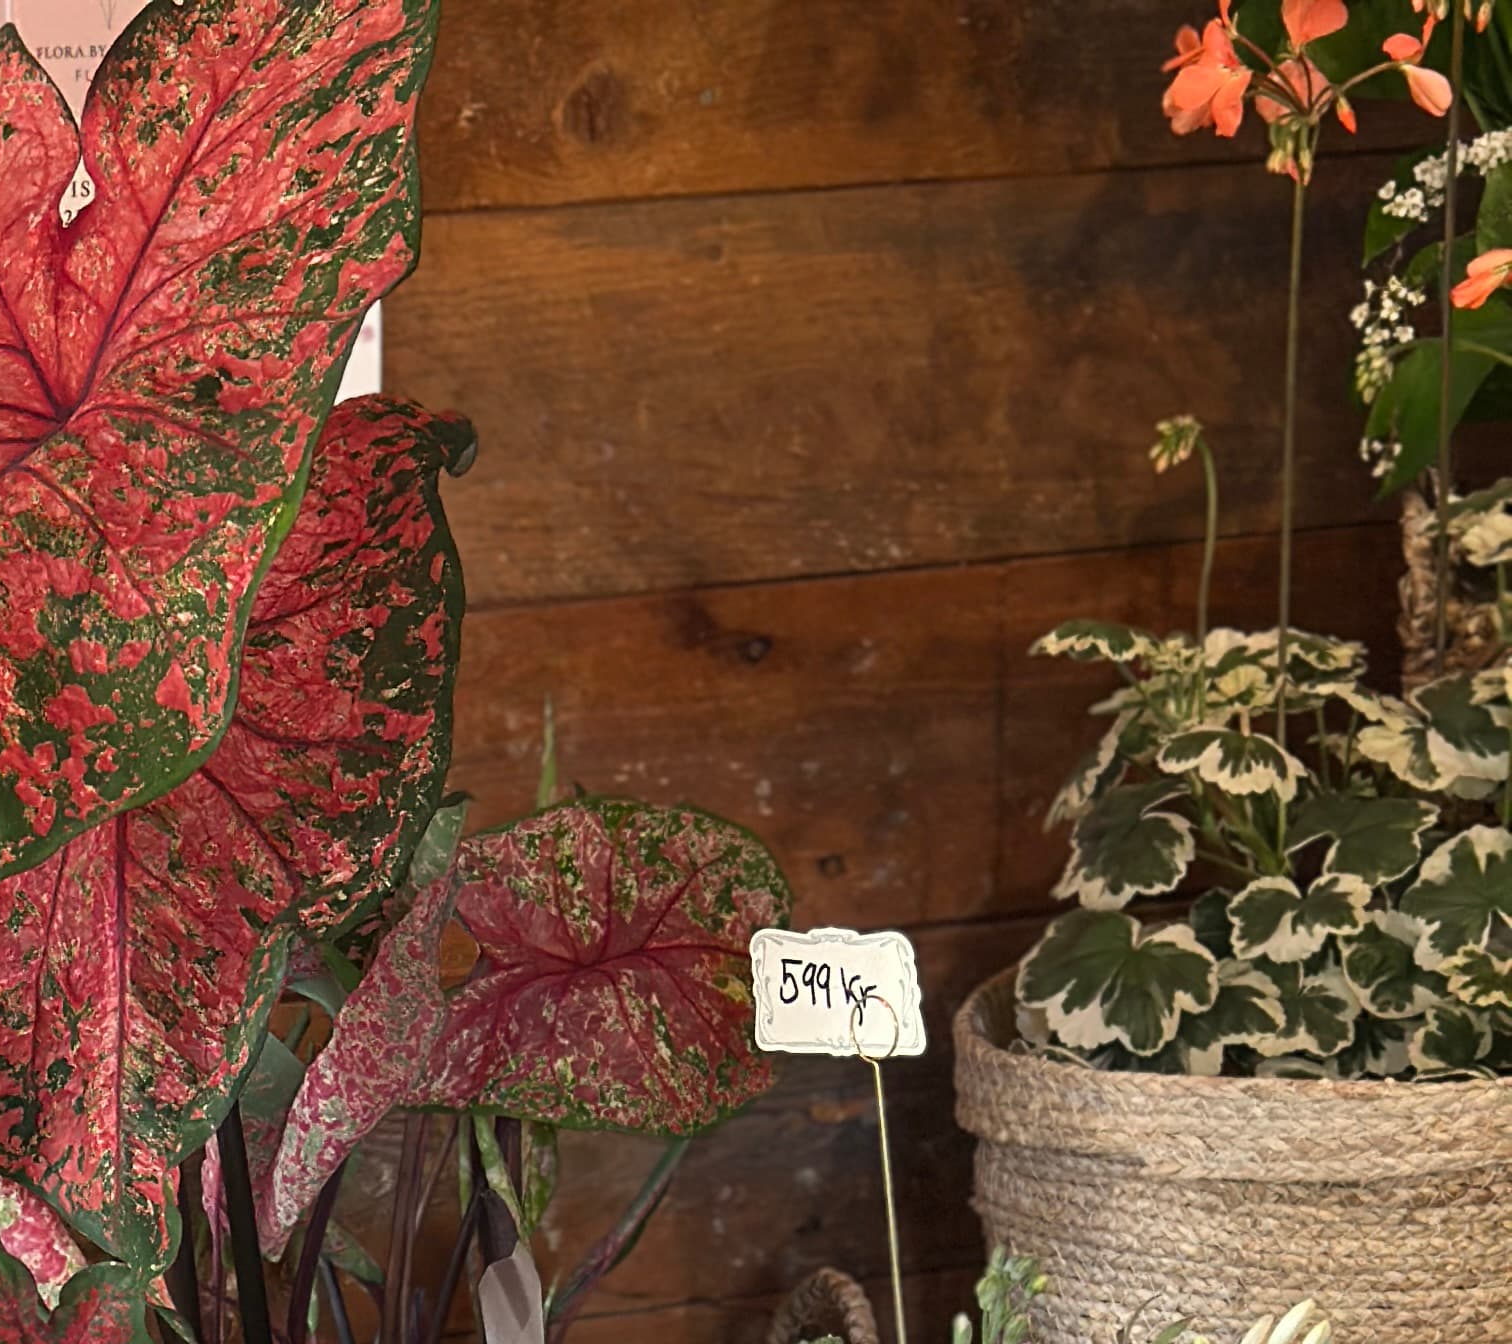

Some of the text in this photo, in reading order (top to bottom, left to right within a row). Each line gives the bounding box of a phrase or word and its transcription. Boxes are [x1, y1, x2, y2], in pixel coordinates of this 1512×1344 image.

[36, 45, 106, 59] FLORA BY
[779, 958, 832, 1009] 599
